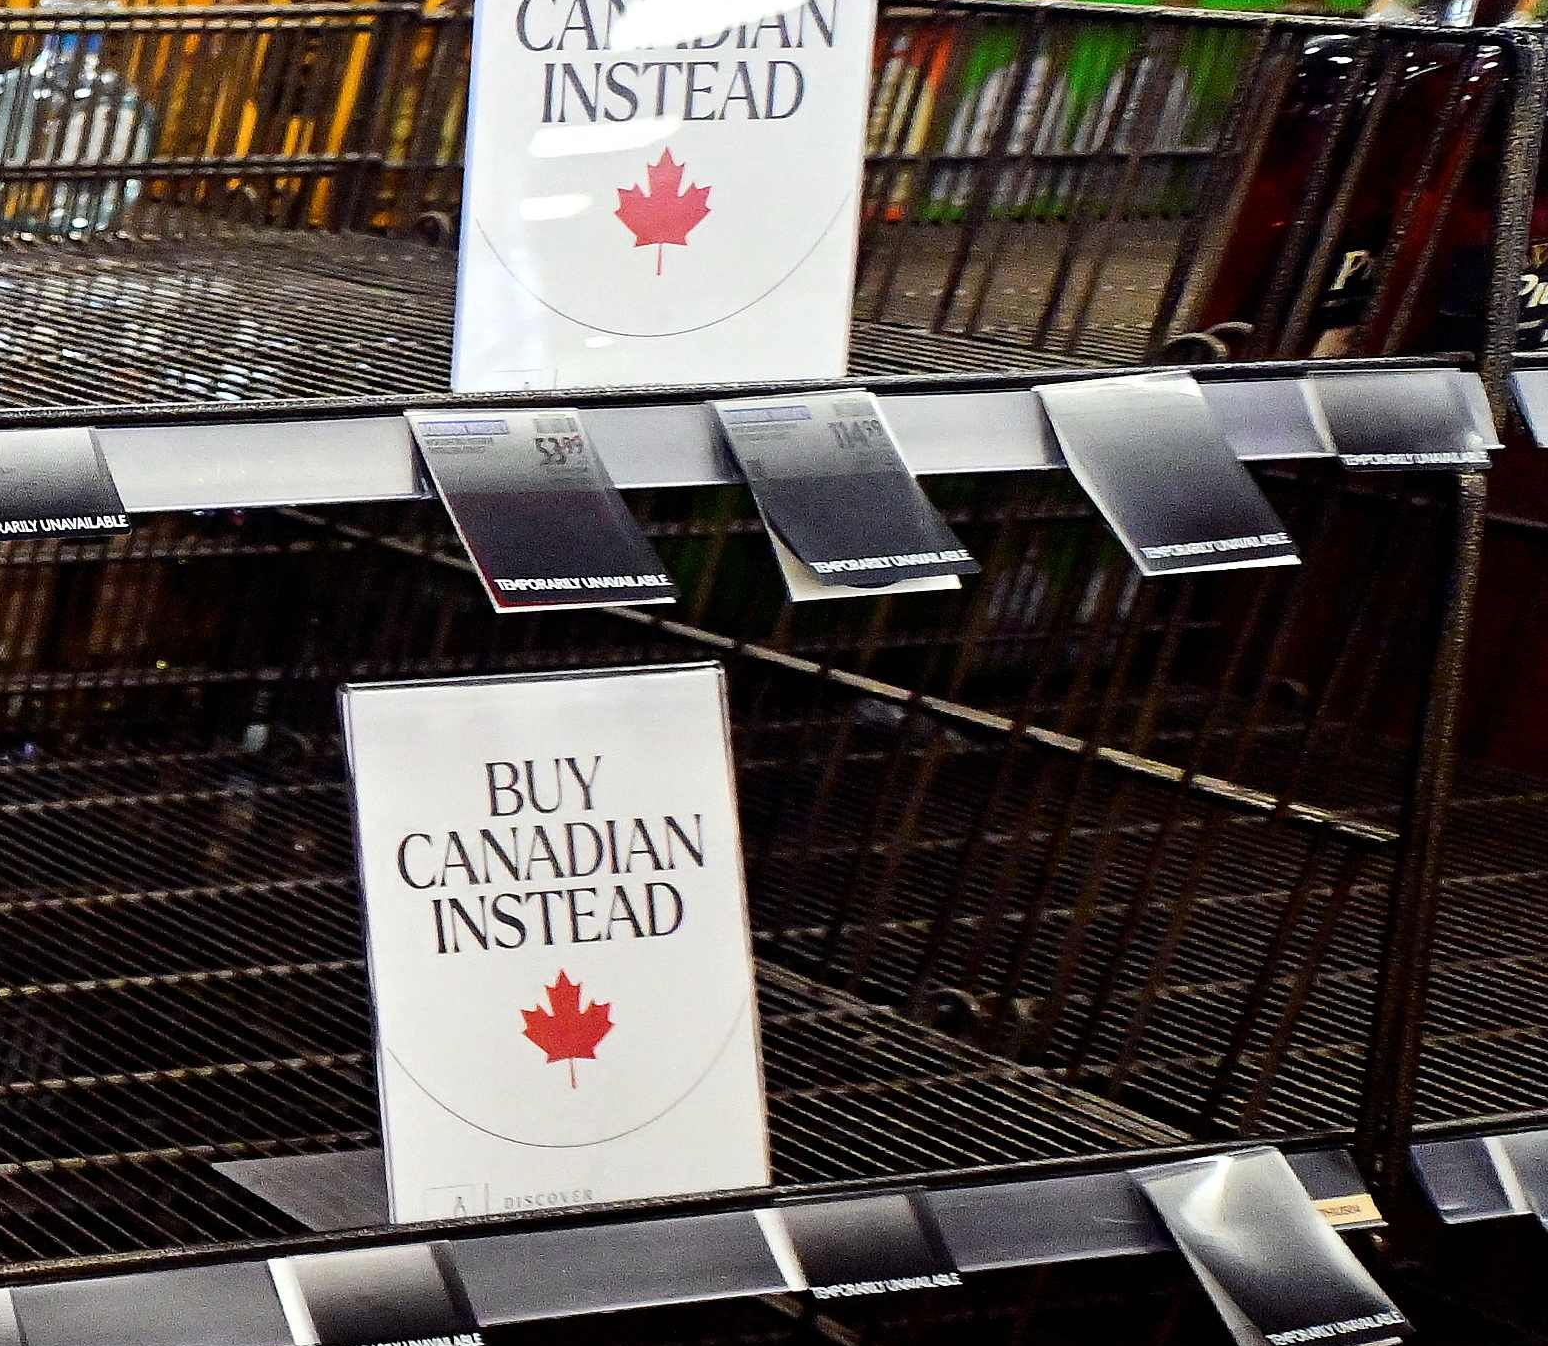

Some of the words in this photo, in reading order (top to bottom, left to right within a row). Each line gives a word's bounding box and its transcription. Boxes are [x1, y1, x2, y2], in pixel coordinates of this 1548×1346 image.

[542, 60, 805, 123] INSTEAD
[41, 515, 128, 532] UNAVAILABLE
[494, 576, 580, 591] TEMPORARILY
[581, 573, 673, 588] UNAVAILABLE
[484, 755, 602, 818] BUY
[396, 814, 705, 890] CANADIAN
[431, 881, 684, 954] INSTEAD
[503, 1188, 594, 1210] DISCOVER
